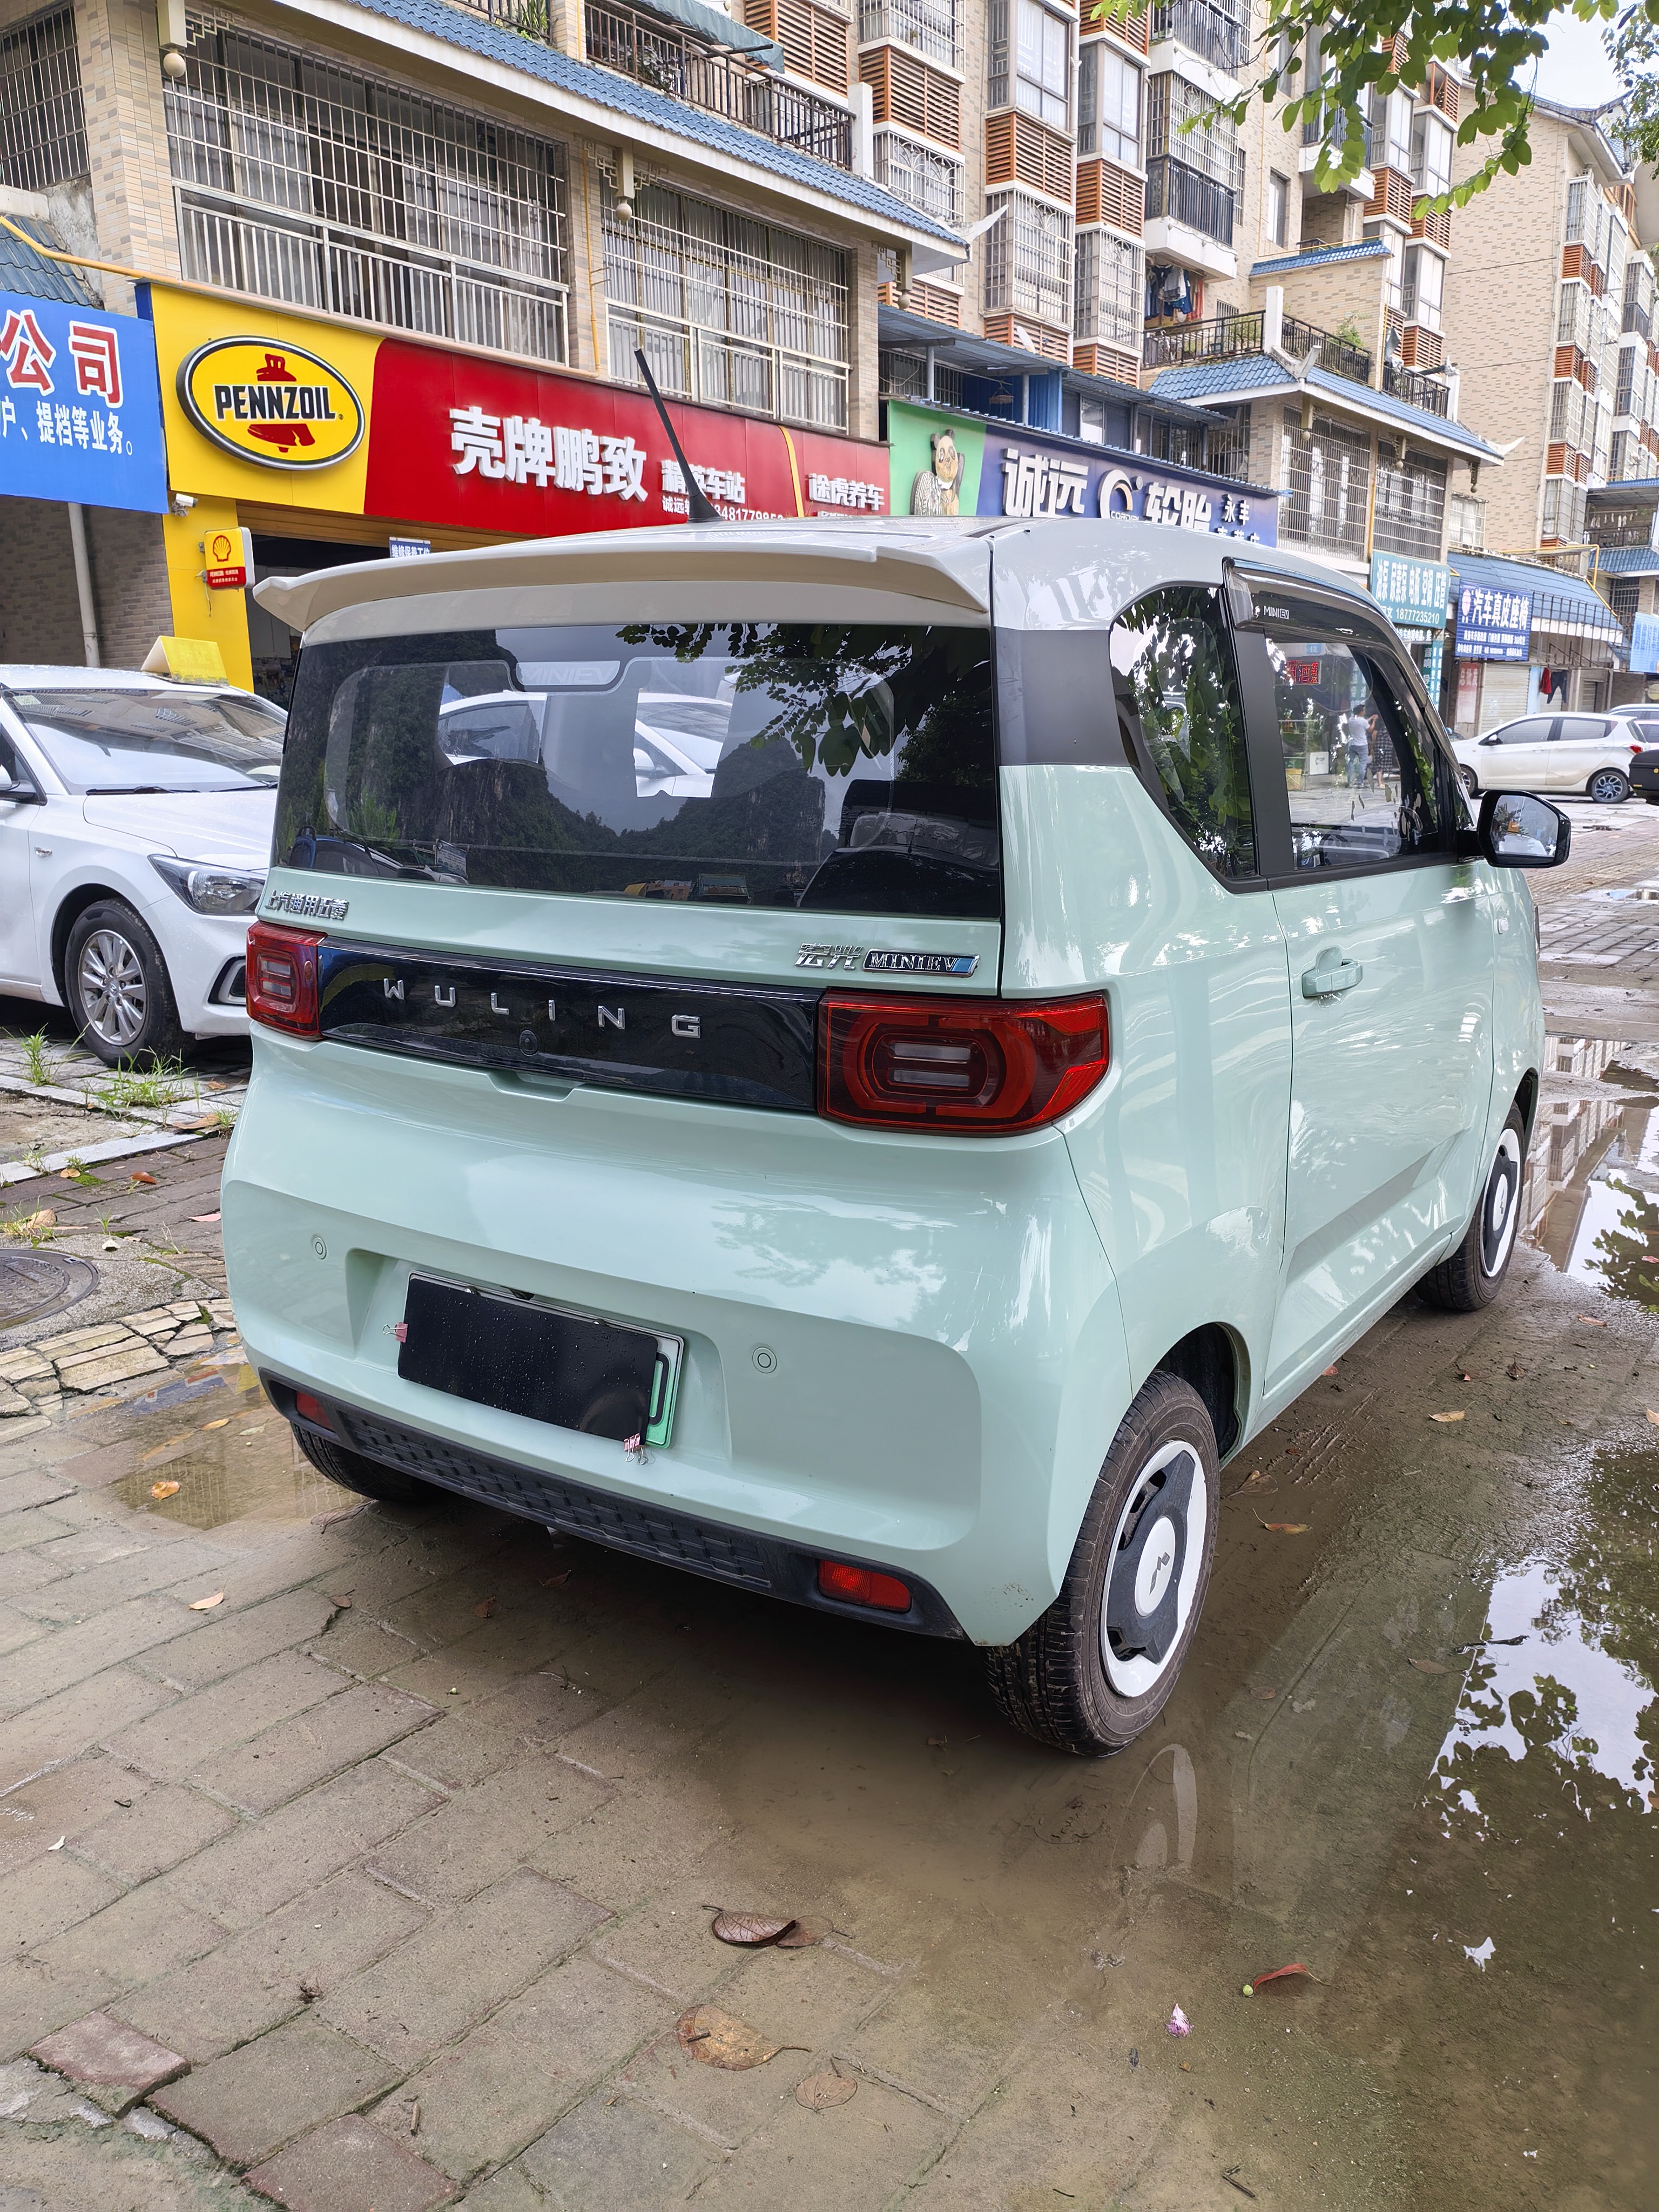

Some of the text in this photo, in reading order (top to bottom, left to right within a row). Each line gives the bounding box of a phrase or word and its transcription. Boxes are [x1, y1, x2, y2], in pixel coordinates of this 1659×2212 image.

[0, 309, 123, 408] 公司
[213, 384, 336, 420] PENNZOIL
[449, 406, 649, 502] 壳牌鹏致
[808, 473, 885, 510] 途虎养车
[1002, 448, 1089, 518] 诚远
[1144, 482, 1212, 532] 轮胎
[1223, 494, 1250, 525] 永丰
[1396, 608, 1440, 624] 18777235210
[1472, 588, 1529, 631] 汽车真皮座椅
[265, 890, 349, 920] 上汽通用五菱
[795, 942, 960, 972] 宏光 MINIEV
[383, 977, 702, 1040] WULING
